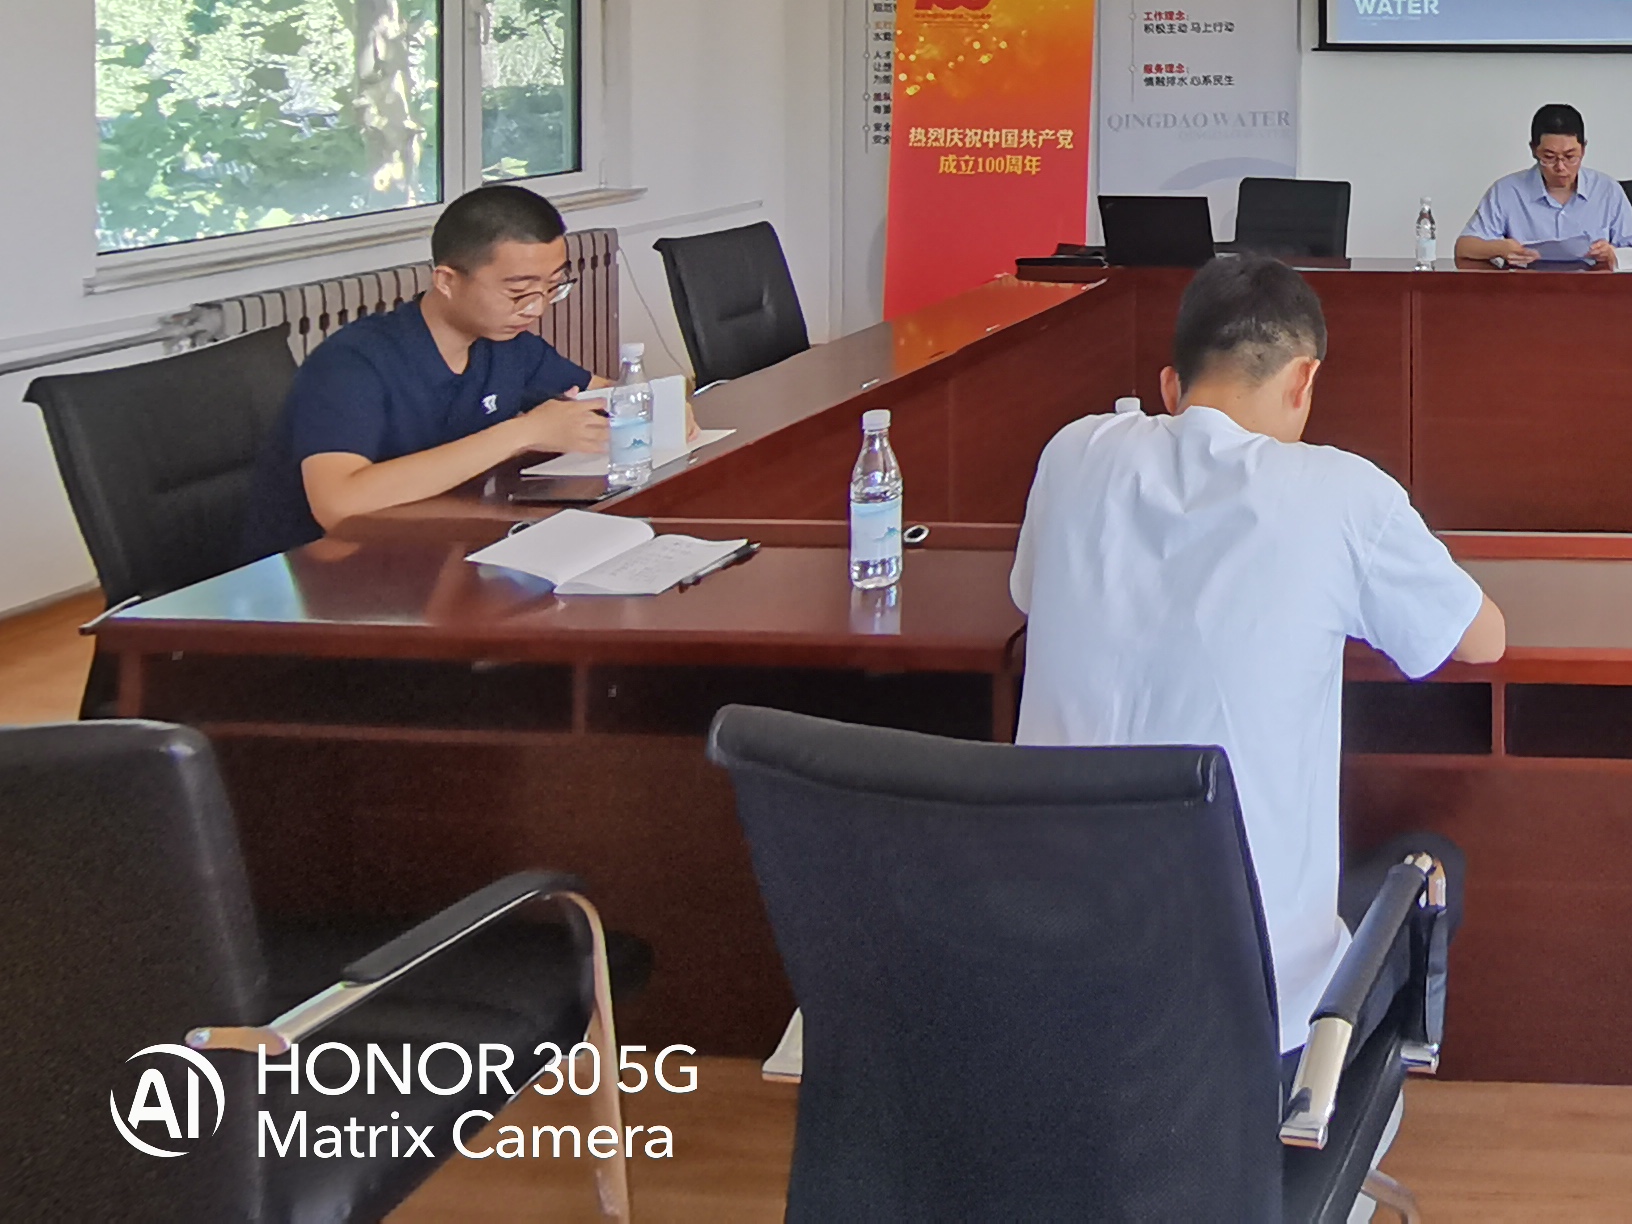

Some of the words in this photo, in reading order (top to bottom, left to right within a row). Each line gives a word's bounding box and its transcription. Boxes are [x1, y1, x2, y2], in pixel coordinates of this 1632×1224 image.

[1190, 21, 1236, 34] 马上行动
[1106, 112, 1209, 132] QINGDAO
[1211, 110, 1291, 129] WATER
[908, 127, 1075, 150] 热烈庆祝中国共产党
[938, 154, 1042, 175] 成立100周年
